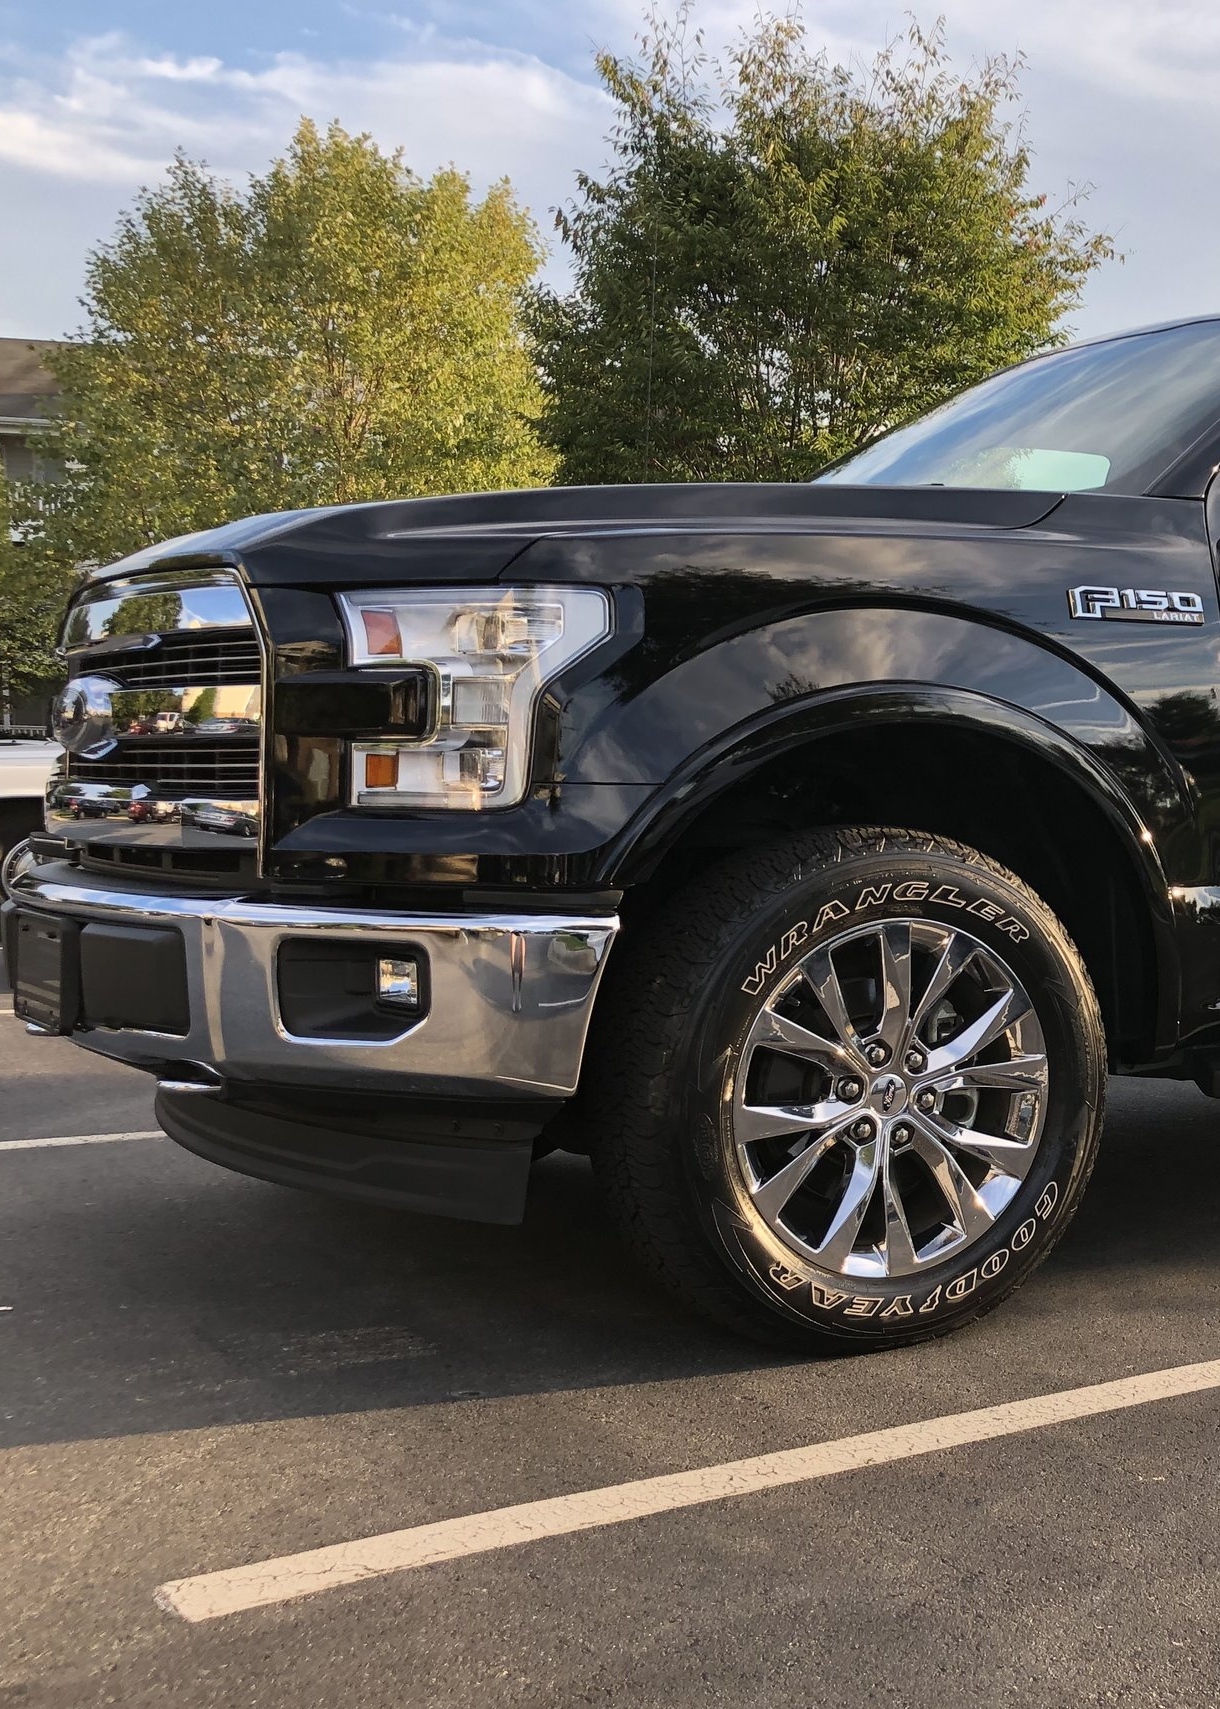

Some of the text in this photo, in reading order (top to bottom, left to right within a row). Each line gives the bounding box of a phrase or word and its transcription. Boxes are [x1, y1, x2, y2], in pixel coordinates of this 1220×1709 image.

[1152, 611, 1200, 622] LARIAT
[741, 881, 1029, 996] WRANGLER
[769, 1181, 1059, 1317] GOODYEAR
